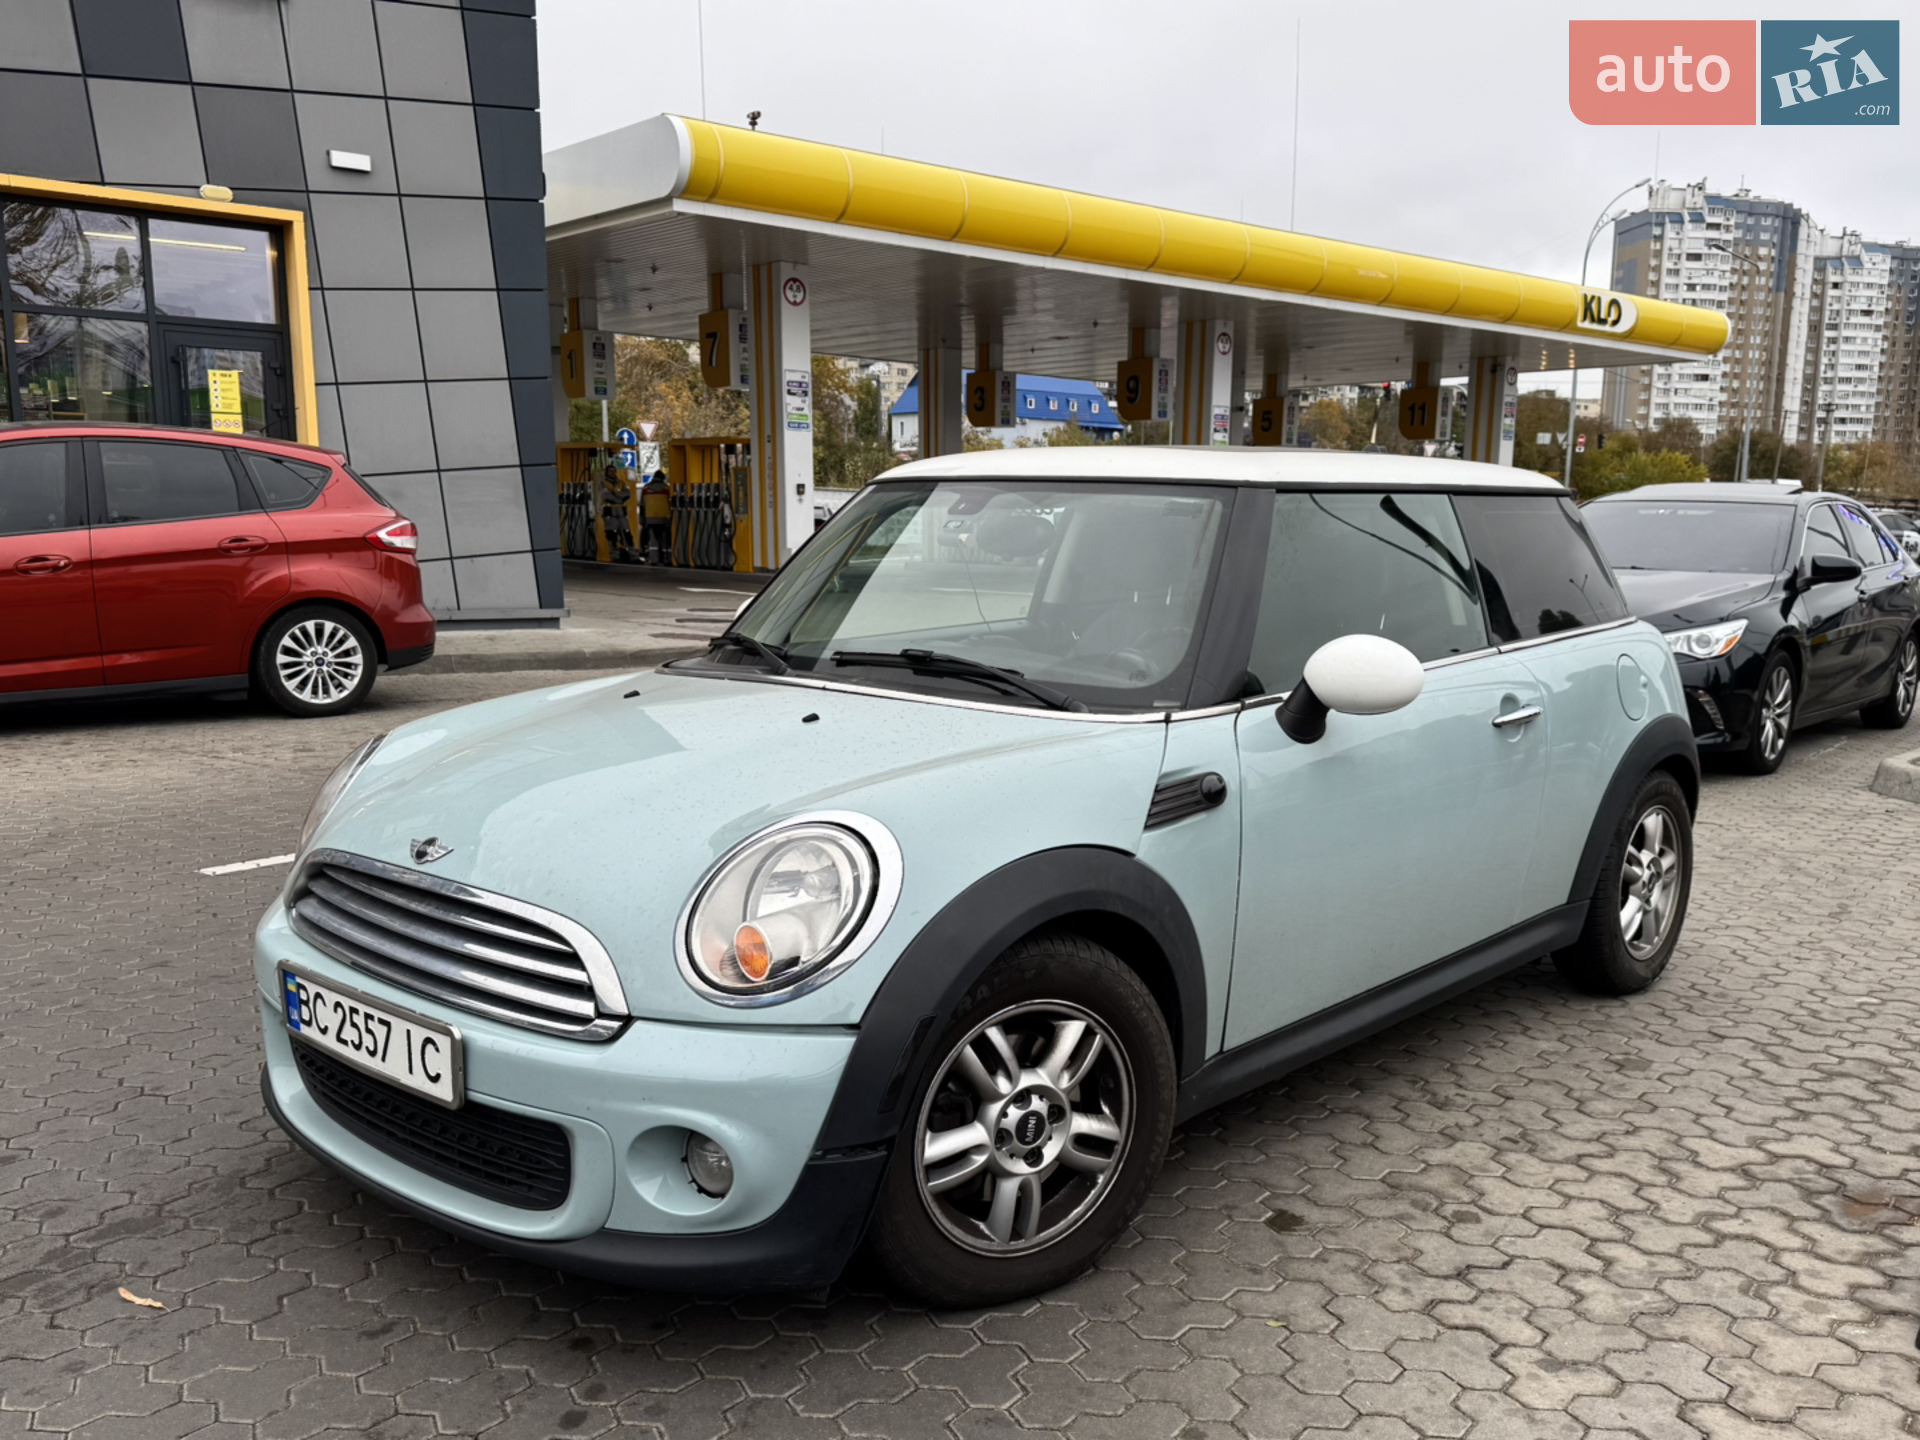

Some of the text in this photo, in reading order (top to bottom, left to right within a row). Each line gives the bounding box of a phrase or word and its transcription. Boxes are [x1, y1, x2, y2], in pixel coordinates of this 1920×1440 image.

[1580, 292, 1623, 328] KLO
[704, 331, 720, 368] 7
[566, 349, 576, 380] 1
[973, 386, 986, 412] 3
[1126, 375, 1141, 404] 9
[1260, 410, 1273, 432] 5
[1408, 402, 1427, 426] 11
[297, 983, 442, 1084] BC 2557 IC
[1024, 1115, 1037, 1143] MINI
